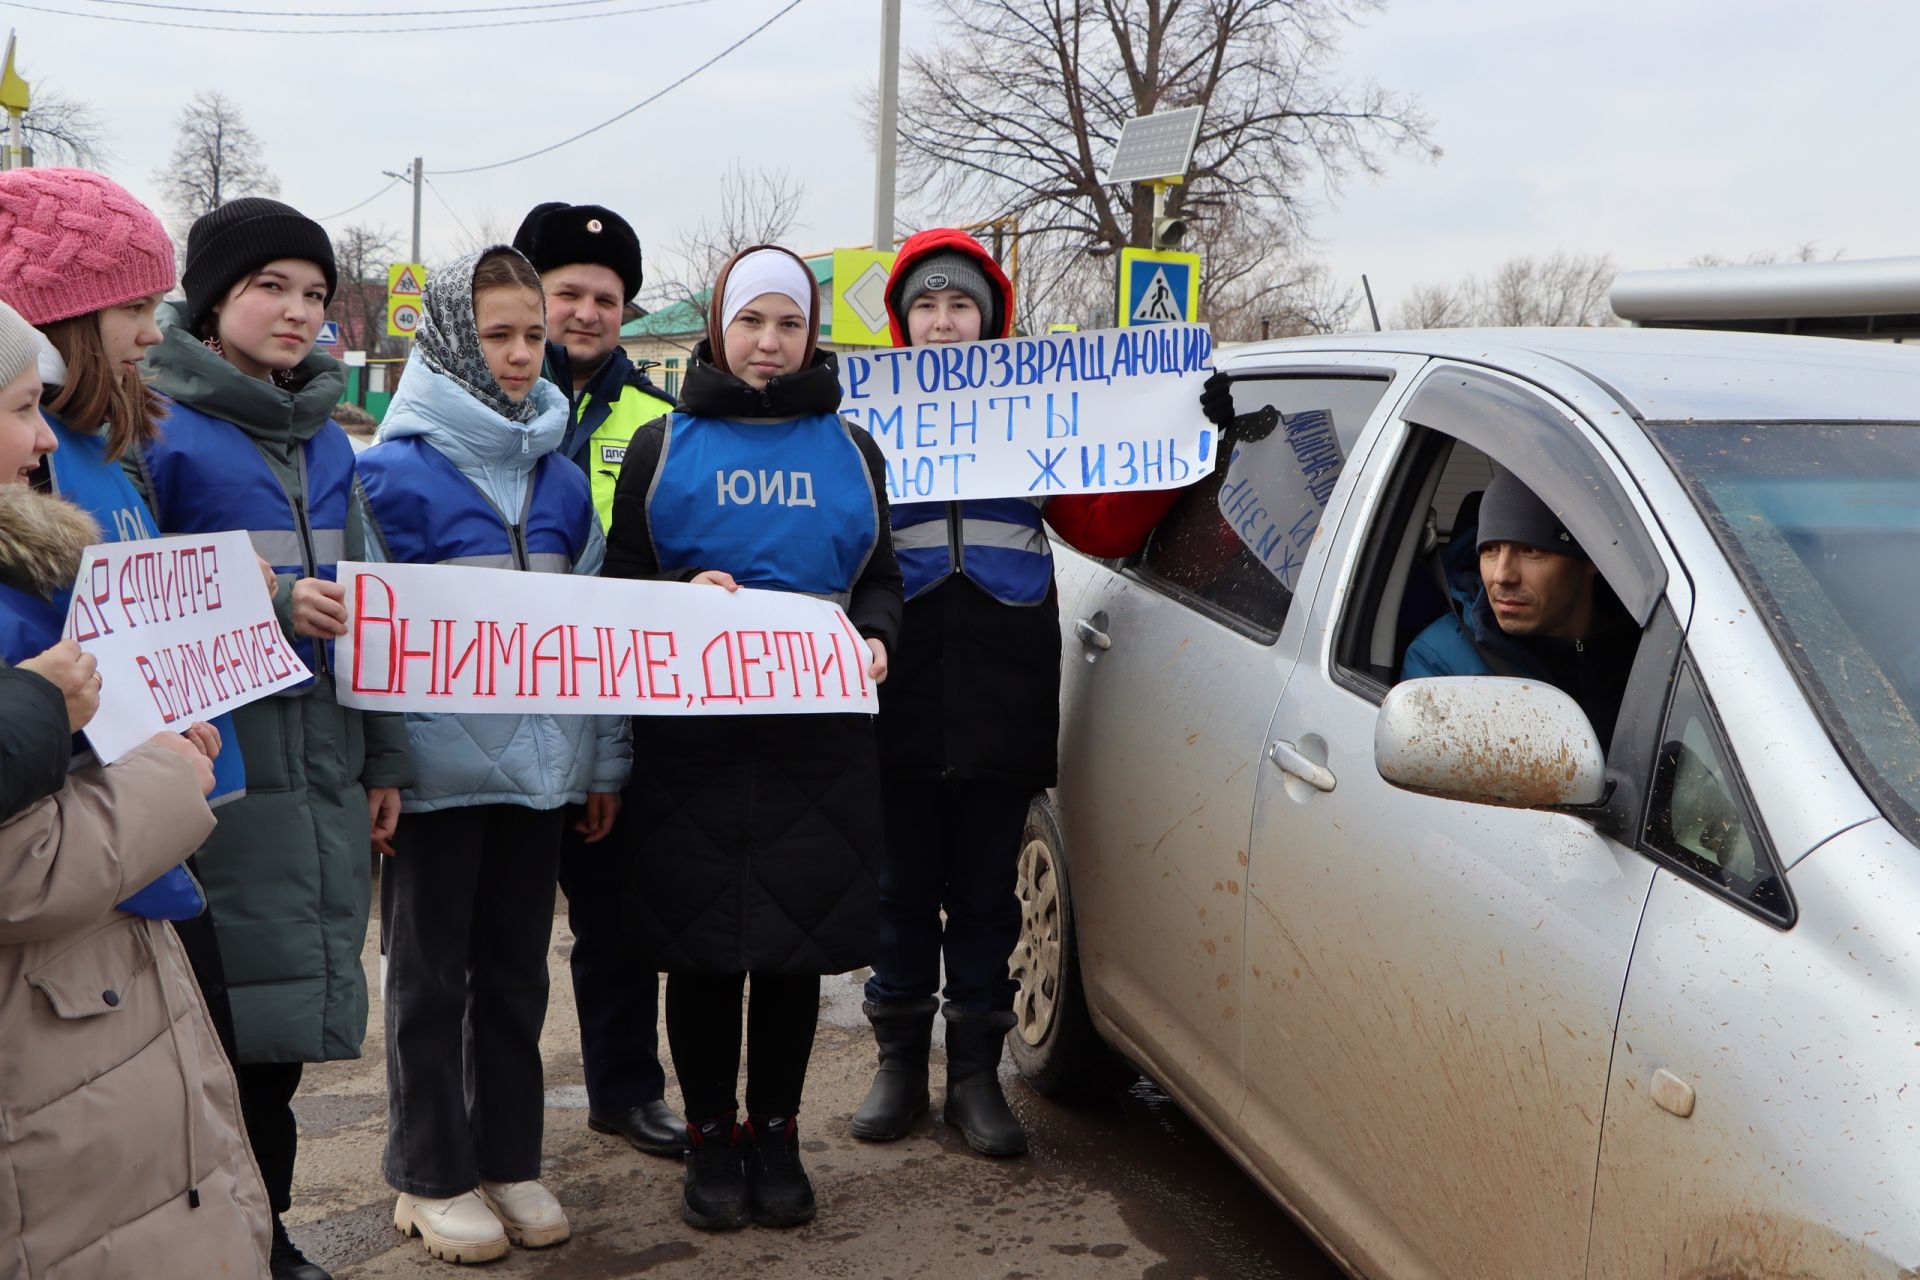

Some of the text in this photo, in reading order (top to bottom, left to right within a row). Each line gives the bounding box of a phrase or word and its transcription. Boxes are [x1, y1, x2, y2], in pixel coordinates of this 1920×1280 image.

[400, 315, 414, 324] 40
[716, 469, 816, 507] ЮИД
[1026, 430, 1212, 492] ЖИЗНЬ!
[136, 619, 301, 724] ВНИМАНИЕ!
[701, 610, 868, 706] ДЕТИ!
